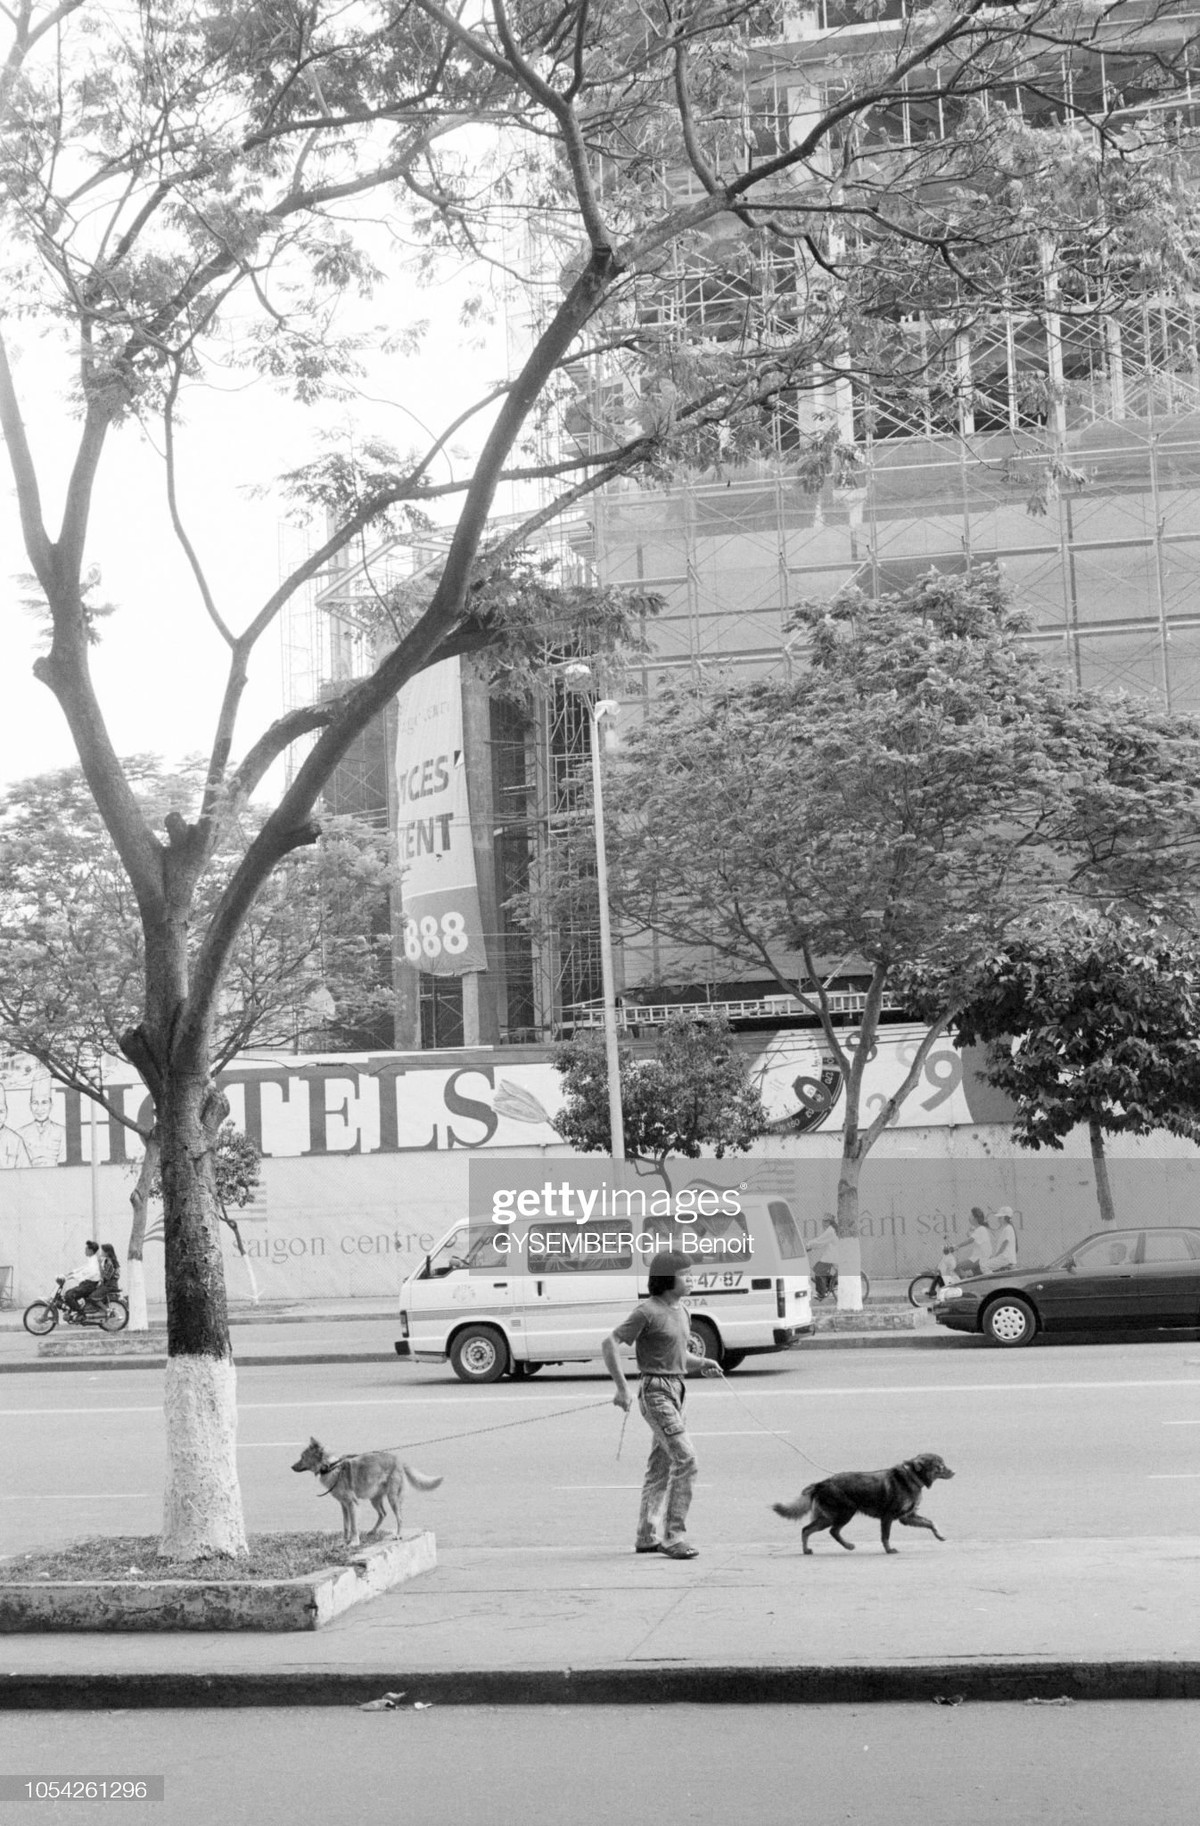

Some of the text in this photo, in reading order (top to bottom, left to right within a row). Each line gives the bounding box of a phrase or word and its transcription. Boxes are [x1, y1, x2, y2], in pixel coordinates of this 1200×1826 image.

[404, 911, 468, 961] 888
[924, 1050, 963, 1112] 9
[53, 1066, 499, 1168] HTELS
[232, 1229, 435, 1264] saigon centre
[858, 1209, 906, 1237] âm
